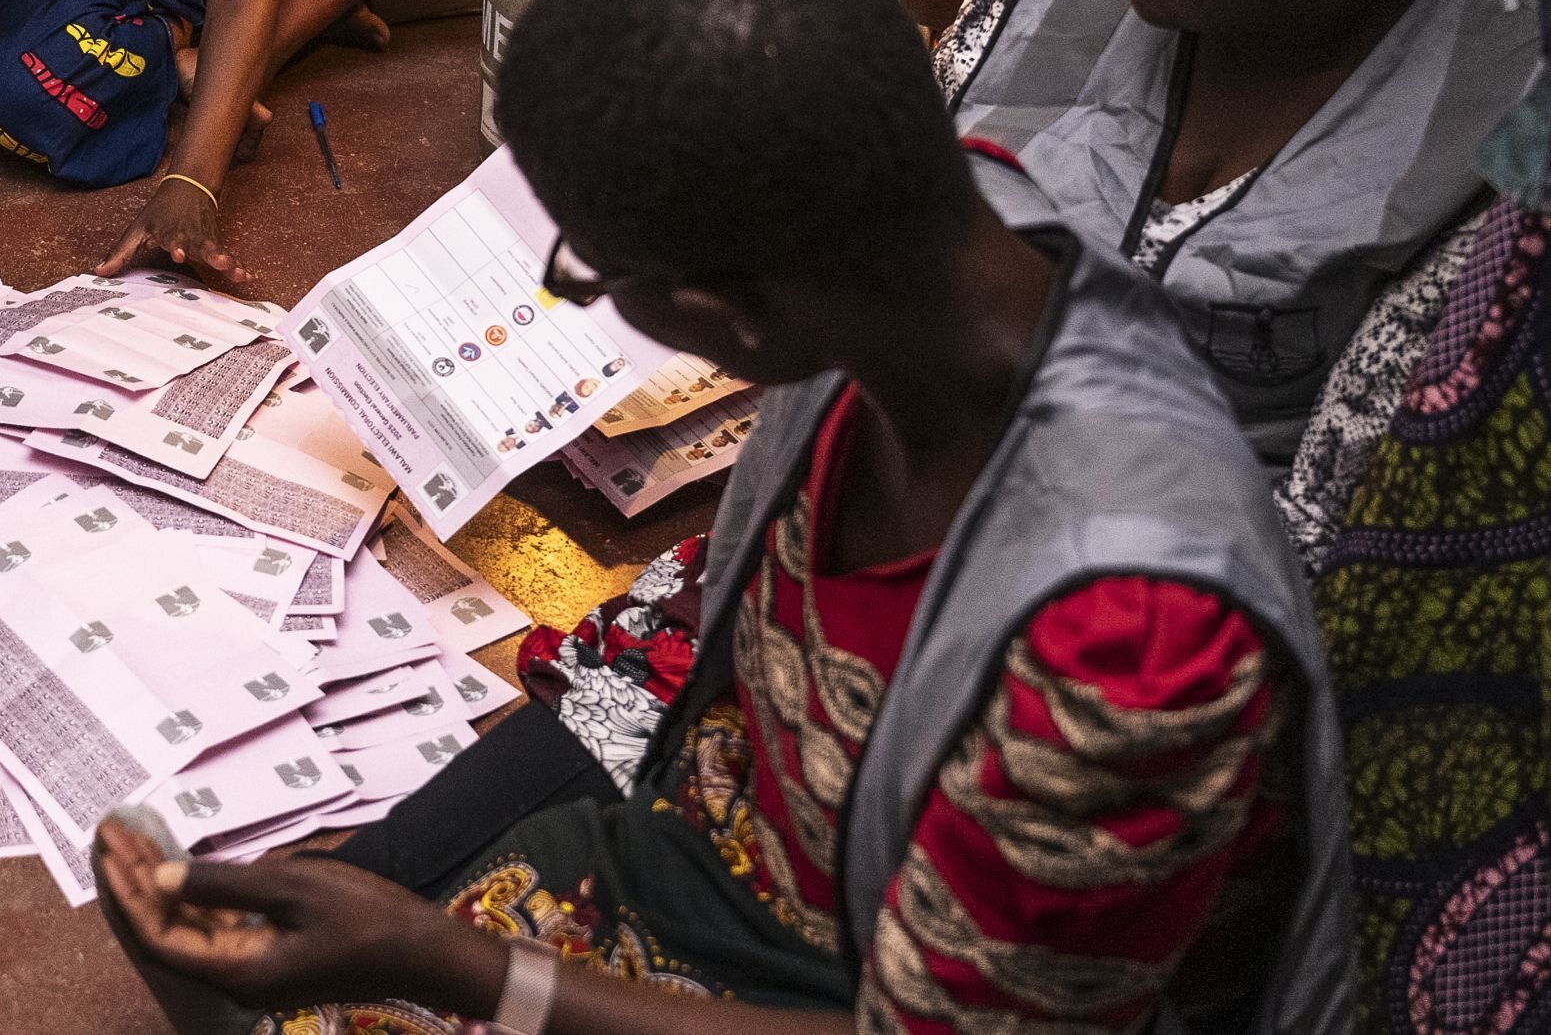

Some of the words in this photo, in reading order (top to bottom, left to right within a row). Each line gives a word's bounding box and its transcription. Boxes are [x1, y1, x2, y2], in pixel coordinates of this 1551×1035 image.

[324, 367, 361, 410] COMMISSION
[355, 362, 381, 392] ELECTION
[352, 380, 373, 405] Election
[357, 409, 391, 447] ELECTORAL
[369, 402, 390, 426] General
[378, 390, 420, 440] PARLIAMENTARY
[387, 424, 402, 441] 2025
[387, 445, 413, 474] MALAWI
